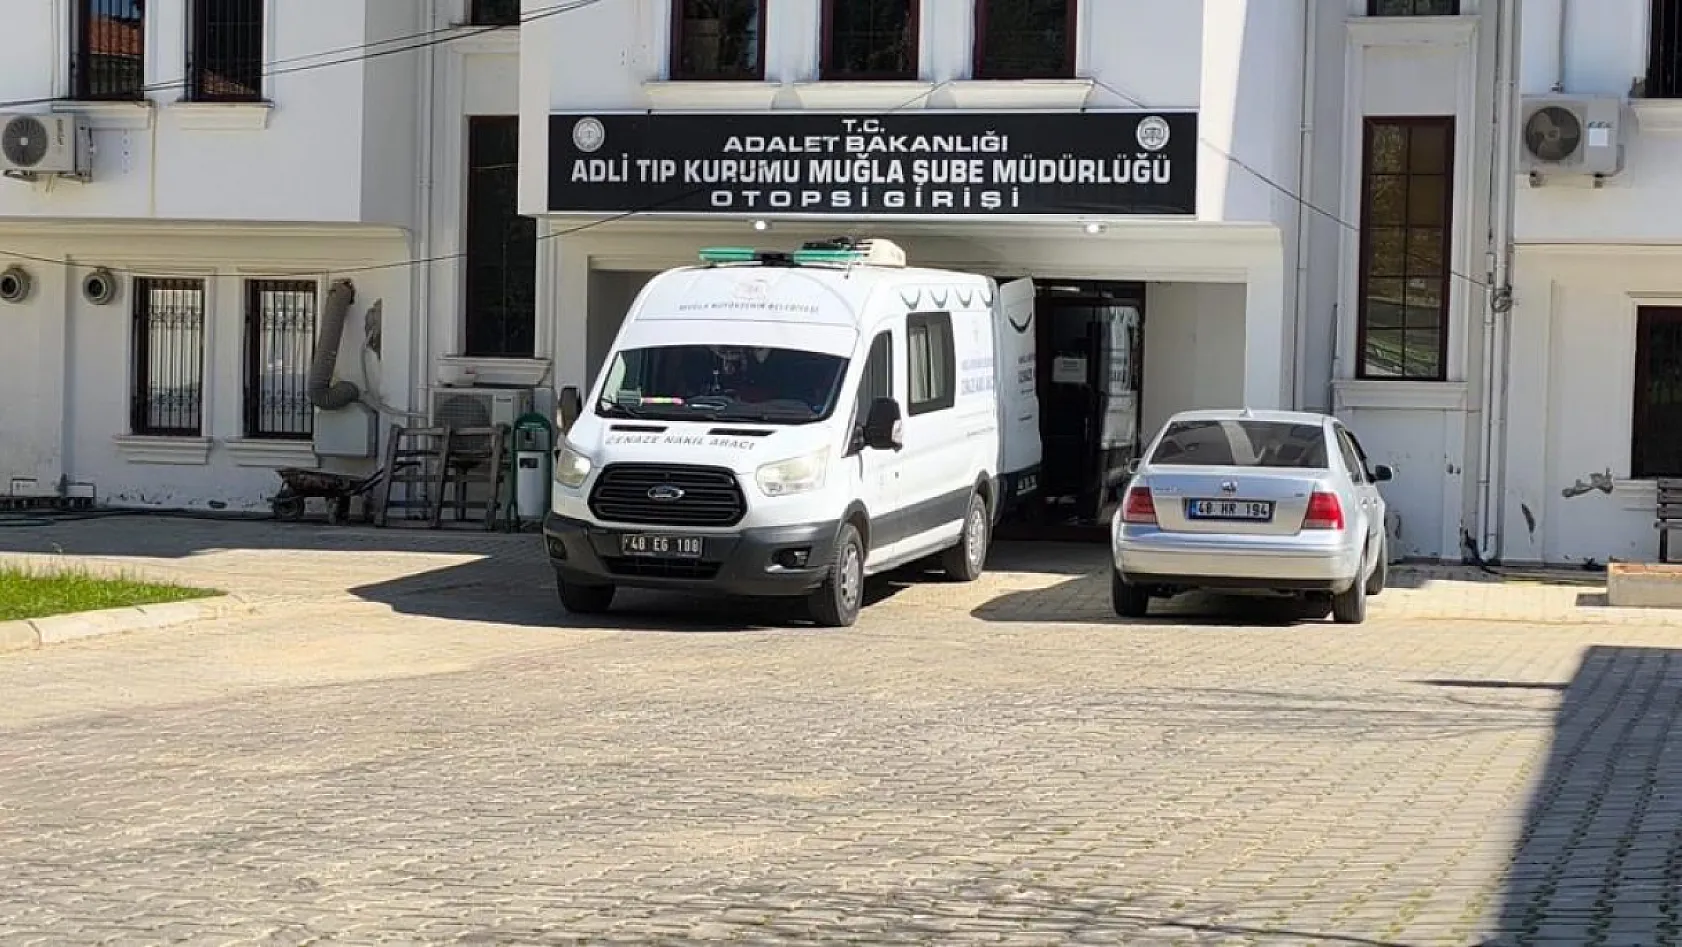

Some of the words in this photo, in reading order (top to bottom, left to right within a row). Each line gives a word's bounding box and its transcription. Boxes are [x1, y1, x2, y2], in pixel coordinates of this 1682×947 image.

[842, 119, 885, 133] T.C.
[723, 136, 841, 153] ADALET
[845, 131, 1009, 153] BAKANLIĞI
[571, 153, 629, 183] ADLİ
[636, 159, 678, 183] TIP
[684, 159, 800, 184] KURUMU
[808, 153, 904, 184] MUĞLA
[912, 159, 985, 188] ŞUBE
[992, 153, 1172, 184] MÜDÜRLÜĞÜ
[710, 186, 870, 208] OTOPSİ
[883, 186, 1020, 210] GİRİŞİ
